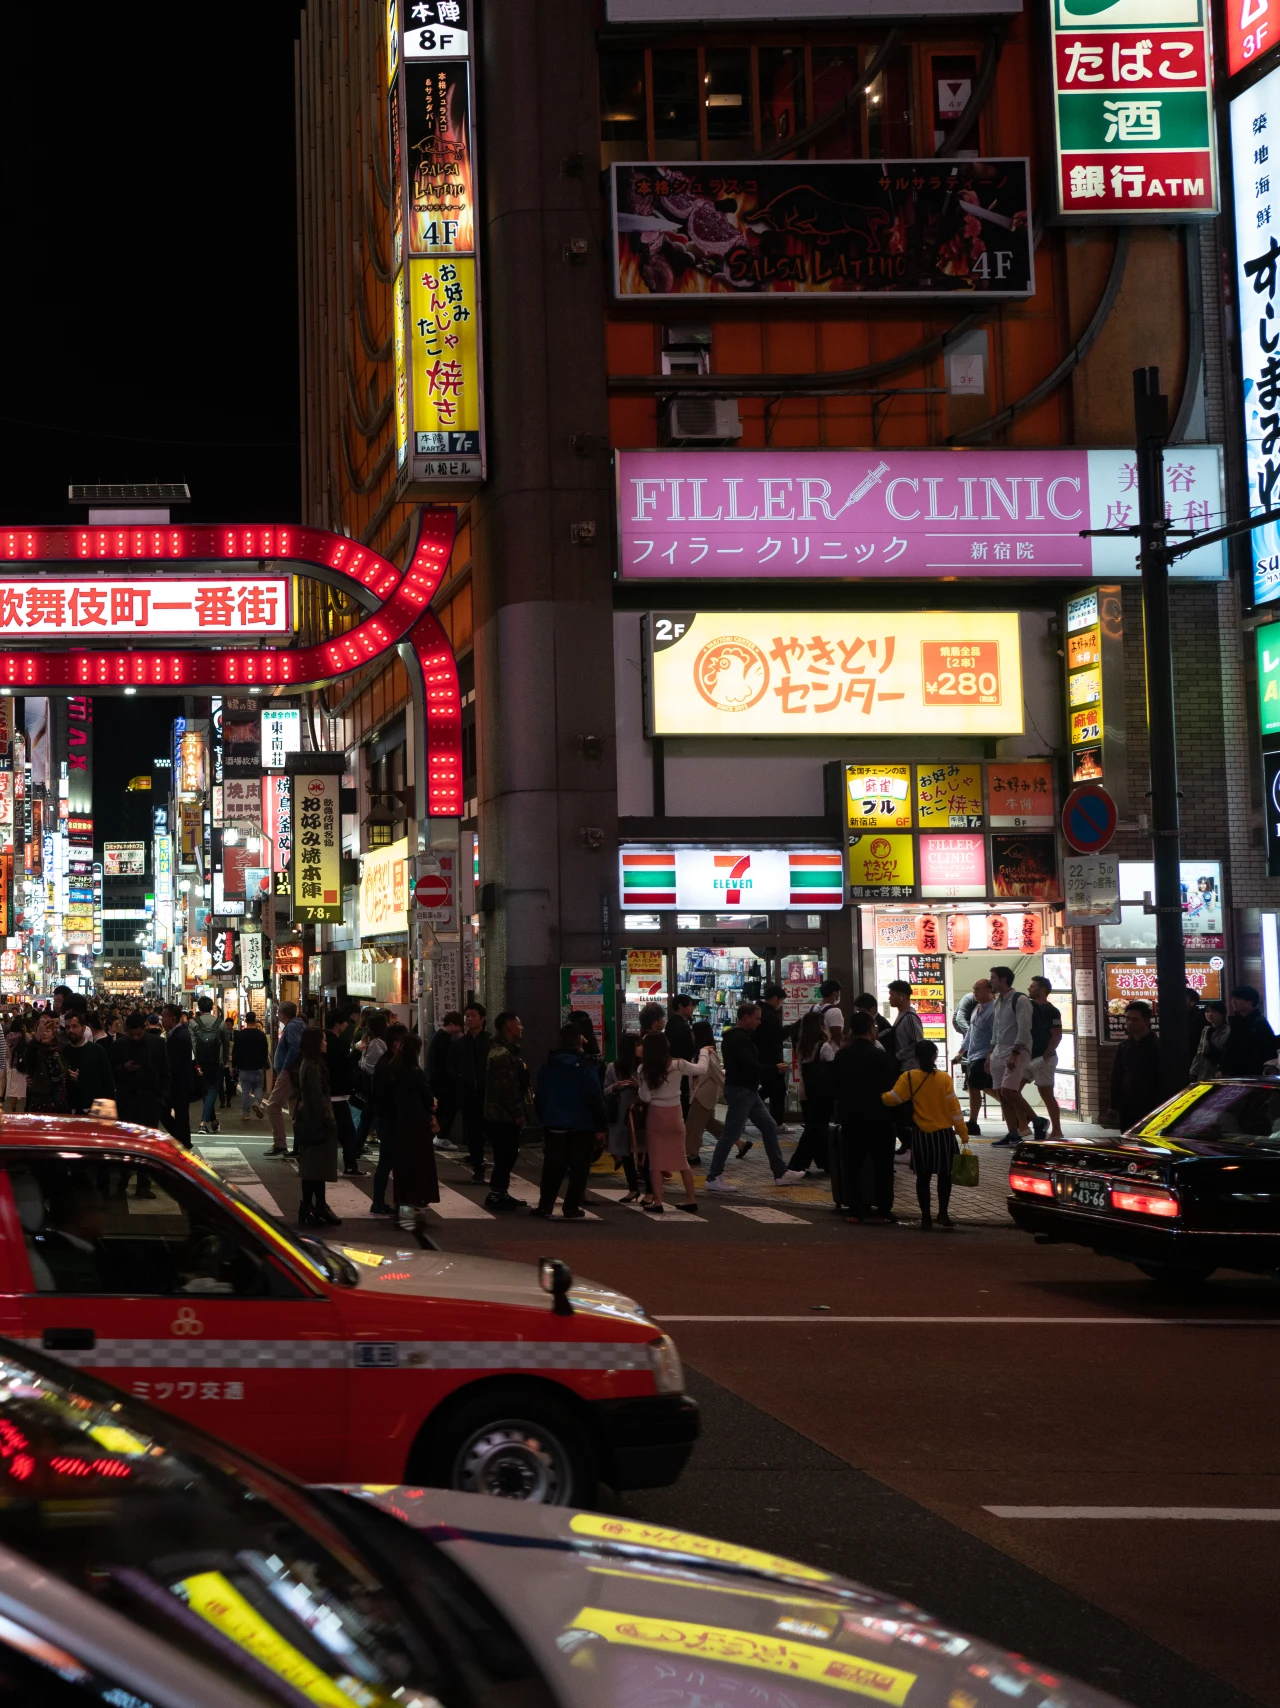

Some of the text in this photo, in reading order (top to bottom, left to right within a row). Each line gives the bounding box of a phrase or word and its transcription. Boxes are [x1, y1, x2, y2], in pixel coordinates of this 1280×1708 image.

[411, 1, 460, 23] 本陣
[418, 29, 454, 51] 8F
[1242, 21, 1269, 59] 3F
[1064, 39, 1198, 83] たばこ
[425, 78, 435, 130] &サラダバー
[437, 71, 448, 133] 本格シュラスコ
[1103, 100, 1163, 143] 酒
[1251, 112, 1273, 230] 築地海鮮
[636, 179, 760, 195] 本格シュラスコ
[878, 174, 1008, 192] サルサラティーノ
[1069, 164, 1205, 199] 銀行ATM
[414, 204, 466, 212] サルサラティーノ
[422, 220, 459, 246] 4F
[971, 250, 1014, 281] 4F
[439, 263, 471, 322] お好み
[421, 272, 460, 350] もんじゃ
[416, 317, 443, 356] たこ
[425, 359, 465, 425] 焼き
[420, 433, 444, 444] 本陣
[421, 443, 446, 453] PART2
[452, 433, 473, 452] 7F
[424, 462, 471, 476] 小松ビル
[629, 476, 1084, 523] FILLER CLINIC
[632, 534, 910, 566] フィラー クリニック
[969, 541, 1036, 561] 新宿院
[654, 618, 686, 641] 2F
[768, 635, 896, 676] やきとり
[939, 645, 981, 658] 焼鳥全品
[925, 671, 998, 697] ¥280
[773, 675, 906, 716] センター
[263, 711, 298, 720] 全卓全自動
[1073, 710, 1099, 729] 麻雀
[1072, 733, 1081, 744] 6F
[1081, 724, 1100, 740] ブル
[849, 766, 907, 775] 全国チェーンの店
[919, 765, 961, 788] お好み
[226, 782, 260, 799] 焼肉
[864, 778, 894, 794] 麻雀
[920, 775, 974, 802] もんじゃ
[993, 775, 1048, 794] お好み焼
[861, 800, 897, 816] ブル
[918, 799, 948, 818] たこ
[947, 794, 982, 815] 焼き
[849, 817, 877, 827] 新宿店
[895, 817, 910, 826] 6F
[969, 815, 982, 827] 7F
[1014, 817, 1027, 827] 8F
[300, 796, 323, 899] お好み焼本陣
[927, 839, 975, 850] FILLER
[863, 859, 899, 872] やきとり
[927, 852, 975, 864] CLINIC
[713, 854, 751, 904] 7
[864, 870, 901, 882] センター
[852, 886, 913, 898] 朝まで営業中
[946, 886, 960, 897] 3F
[416, 911, 448, 921] 自転車を除く
[922, 919, 936, 949] たこ焼
[991, 919, 1005, 948] もんじゃ
[1021, 918, 1035, 949] お好み焼
[628, 950, 662, 959] ATM
[1077, 1188, 1106, 1206] 43-66
[132, 1381, 245, 1400] ミツワ交通
